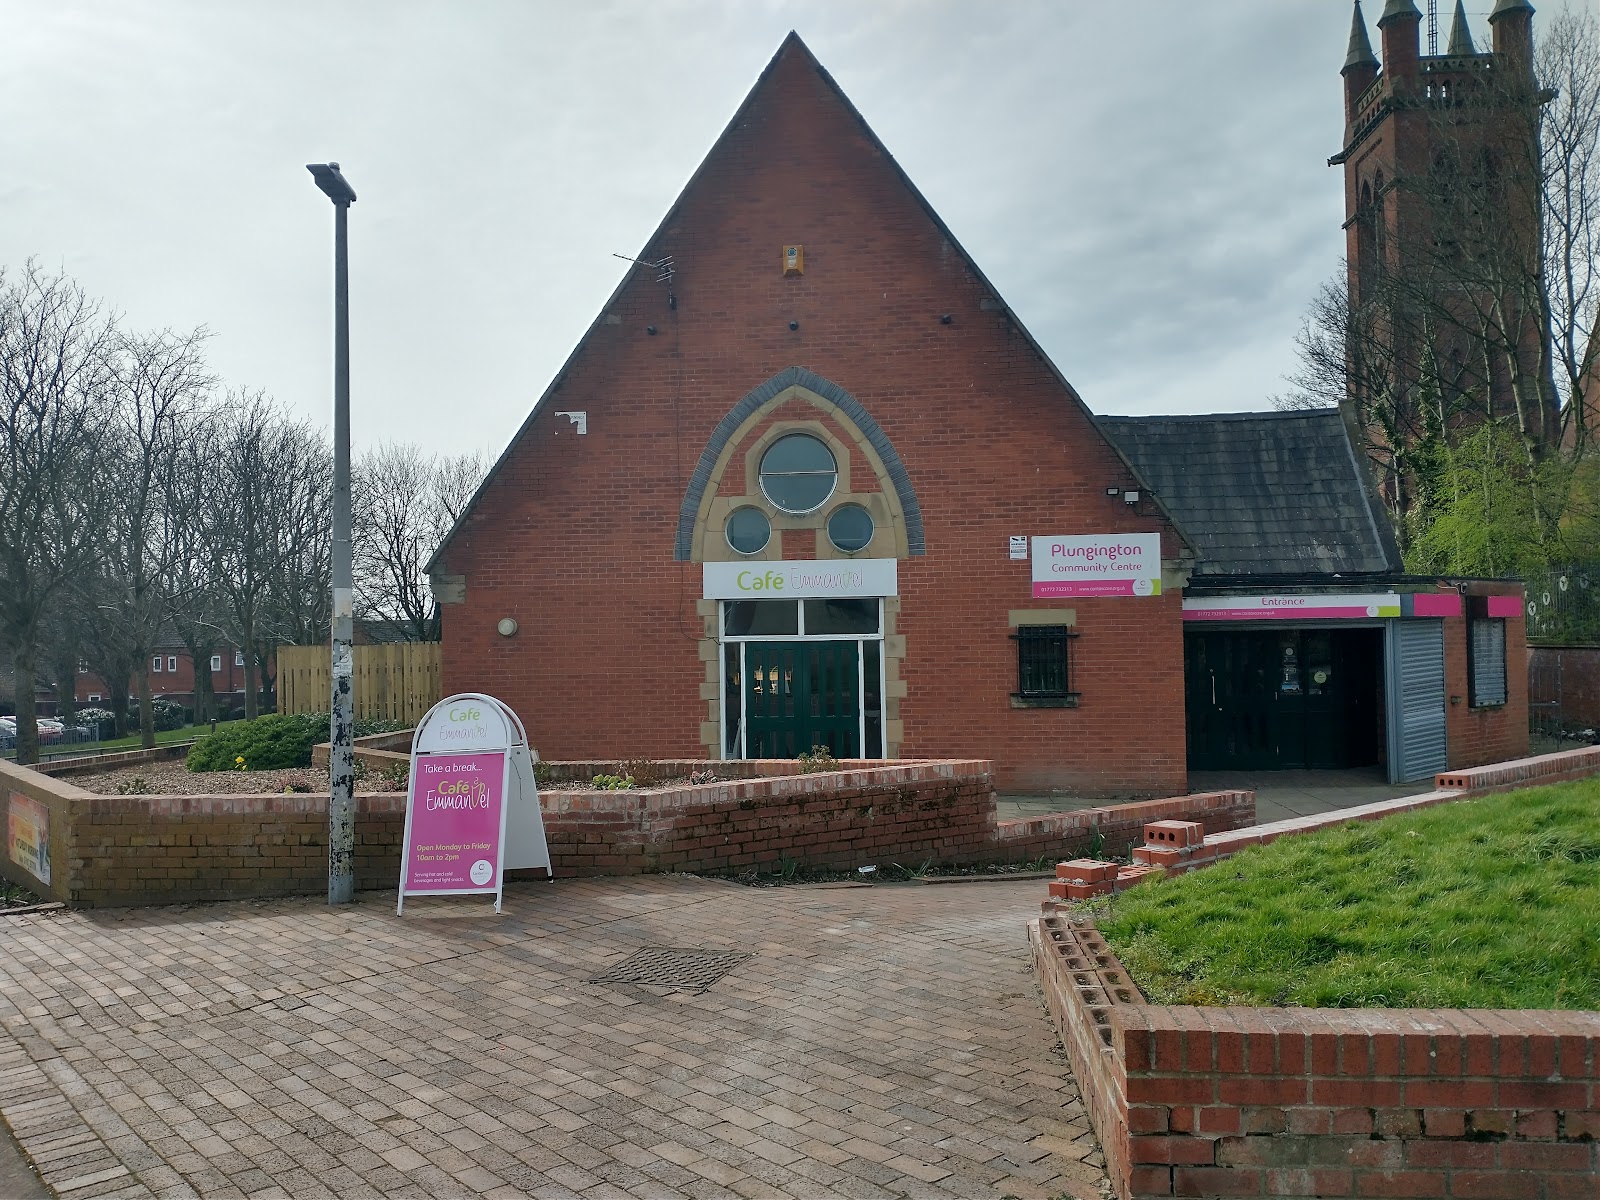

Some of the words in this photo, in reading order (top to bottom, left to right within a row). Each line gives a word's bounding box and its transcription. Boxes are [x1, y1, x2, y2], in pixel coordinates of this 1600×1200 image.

[1051, 543, 1142, 561] Plungington
[1051, 562, 1108, 573] Community
[1110, 561, 1142, 571] Centre
[737, 570, 784, 591] Café
[1261, 597, 1305, 606] Entrance
[449, 707, 481, 722] Café
[423, 764, 443, 774] Take
[444, 765, 451, 773] a
[452, 762, 483, 773] break...
[438, 780, 470, 795] Café
[416, 844, 434, 853] Open
[435, 843, 462, 852] Monday
[471, 842, 491, 851] Friday
[416, 854, 435, 862] 10am
[444, 853, 460, 862] 2pm
